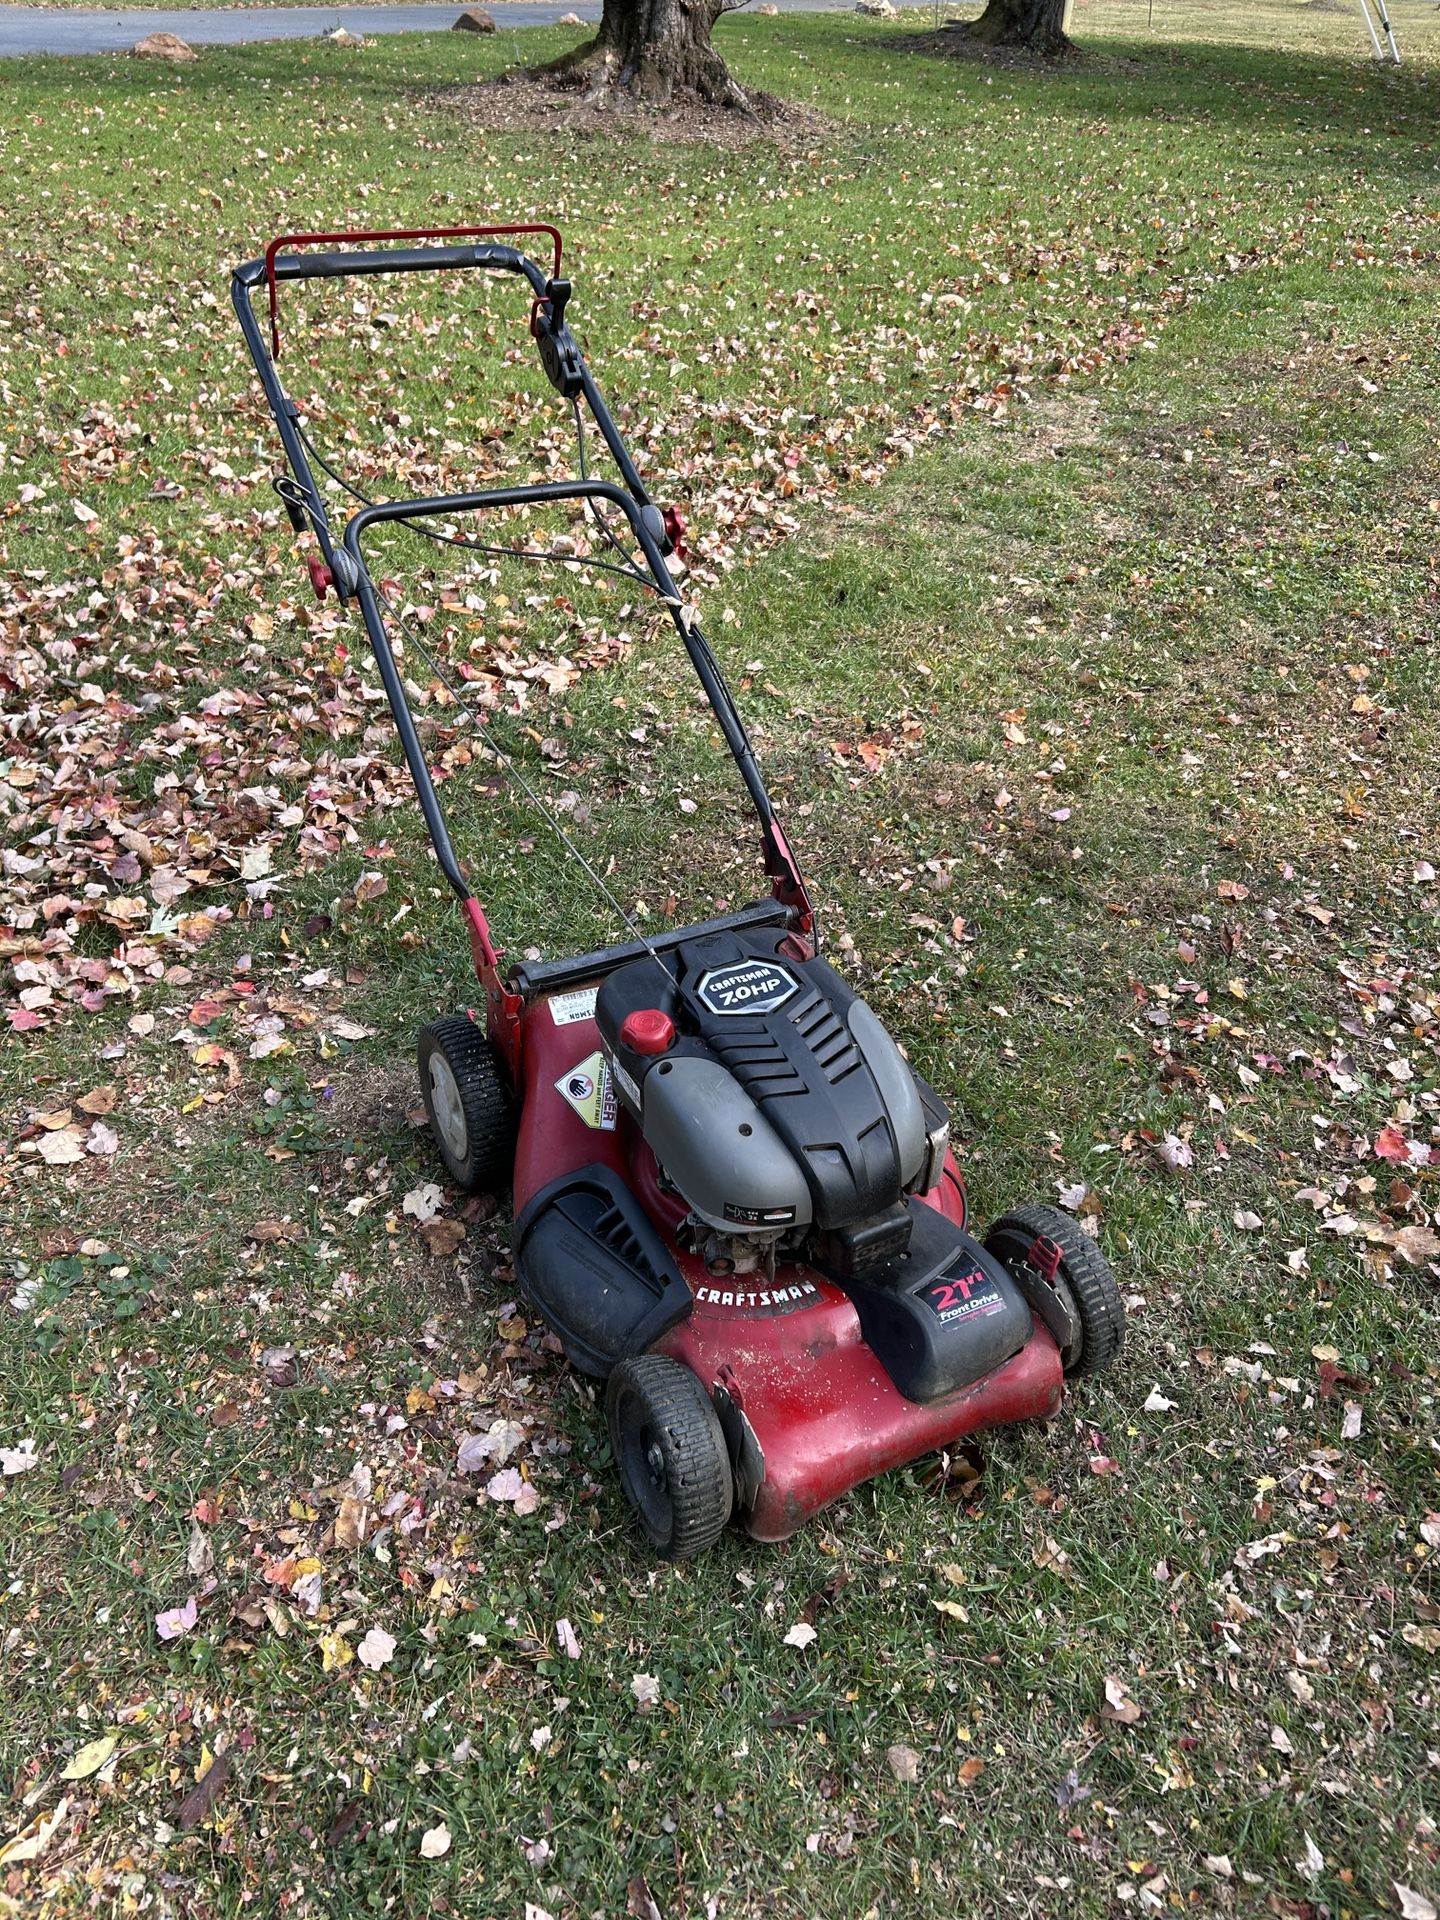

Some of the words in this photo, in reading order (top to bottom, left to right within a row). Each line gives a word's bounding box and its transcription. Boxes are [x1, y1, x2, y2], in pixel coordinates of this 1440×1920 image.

[709, 968, 771, 992] CRAFTSMAN
[696, 1280, 816, 1306] CRAFTSMAN
[940, 1303, 970, 1321] Front
[969, 1292, 999, 1309] Drive
